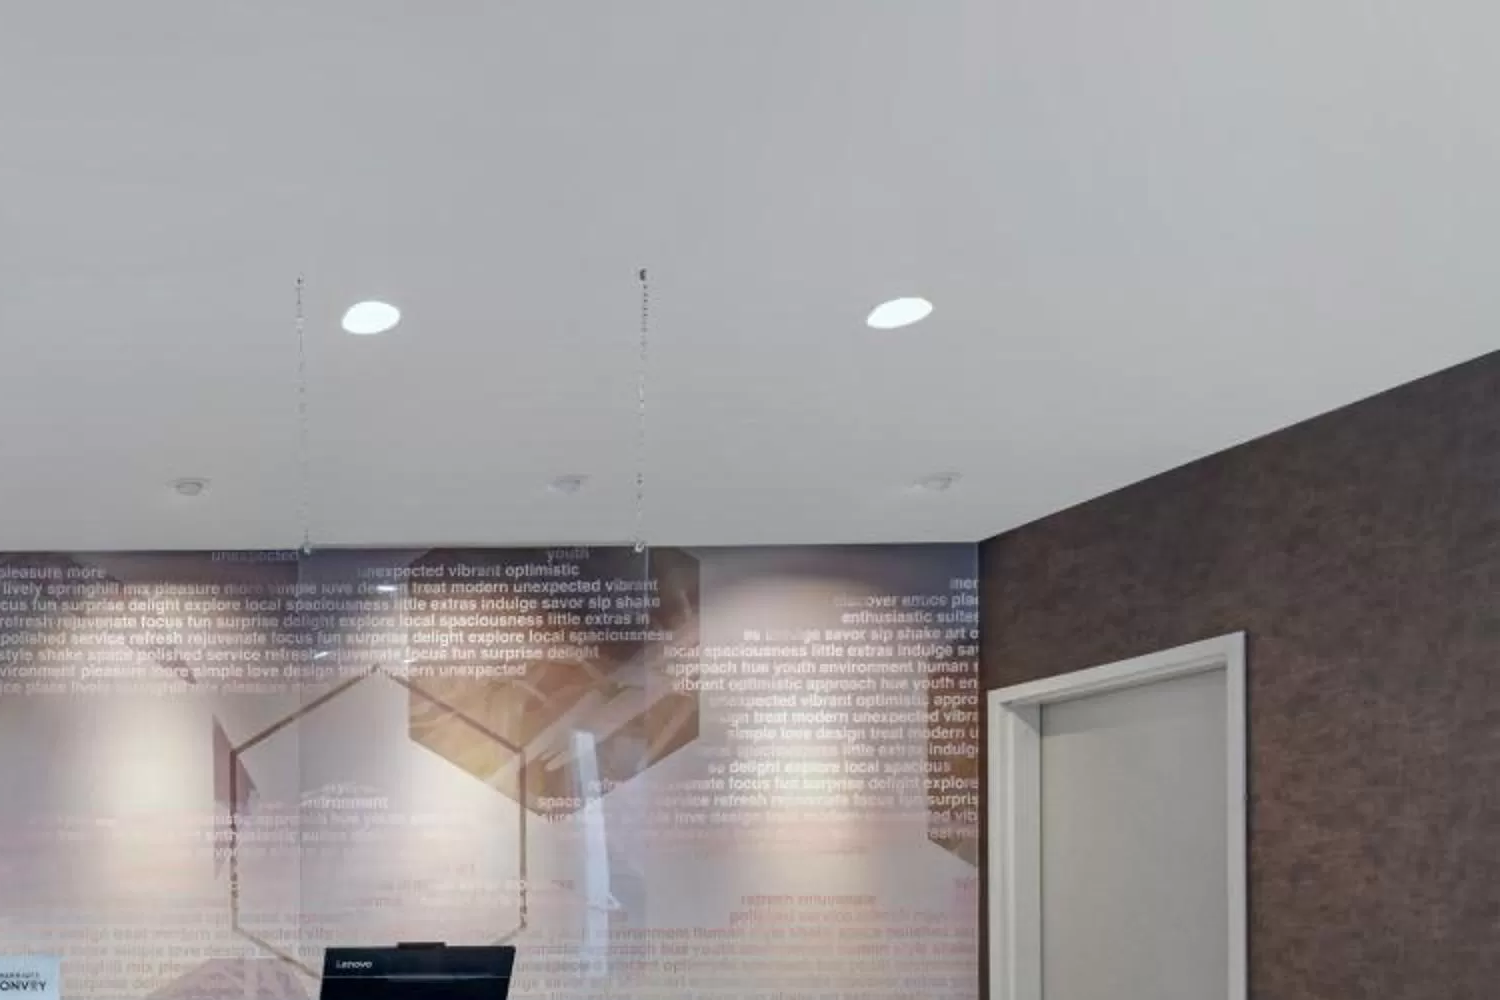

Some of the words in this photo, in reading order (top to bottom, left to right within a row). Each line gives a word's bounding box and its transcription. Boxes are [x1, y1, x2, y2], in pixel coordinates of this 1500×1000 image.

[68, 569, 105, 579] more
[449, 564, 500, 577] vibrant
[506, 564, 579, 580] optimistic
[3, 582, 42, 599] lively
[48, 582, 119, 599] springhill
[155, 582, 219, 599] pleasure
[412, 581, 446, 593] treat
[451, 580, 508, 593] modern
[514, 580, 600, 597] unexpected
[605, 580, 658, 592] vibrant
[32, 599, 56, 612] fun
[61, 600, 123, 616] surprise
[128, 599, 180, 616] delight
[185, 599, 240, 616] explore
[245, 599, 281, 612] local
[286, 599, 391, 615] spaciousness
[430, 598, 477, 610] extras
[481, 597, 538, 614] indulge
[542, 600, 583, 610] savor
[615, 597, 660, 609] shake
[55, 616, 136, 632] rejuvenate
[141, 615, 182, 628] focus
[217, 616, 278, 632] surprise
[339, 614, 394, 631] explore
[440, 614, 543, 630] spaciousness
[548, 613, 581, 626] little
[585, 613, 632, 625] extras
[0, 632, 65, 649] polished
[71, 632, 125, 644] service
[130, 632, 181, 644] refresh
[272, 631, 313, 644] focus
[413, 630, 463, 647] delight
[469, 630, 525, 646] explore
[529, 629, 564, 642] local
[569, 629, 673, 646] spaciousness
[207, 649, 260, 661] service
[480, 647, 543, 663] surprise
[248, 664, 278, 677] love
[336, 959, 372, 968] Lenovo
